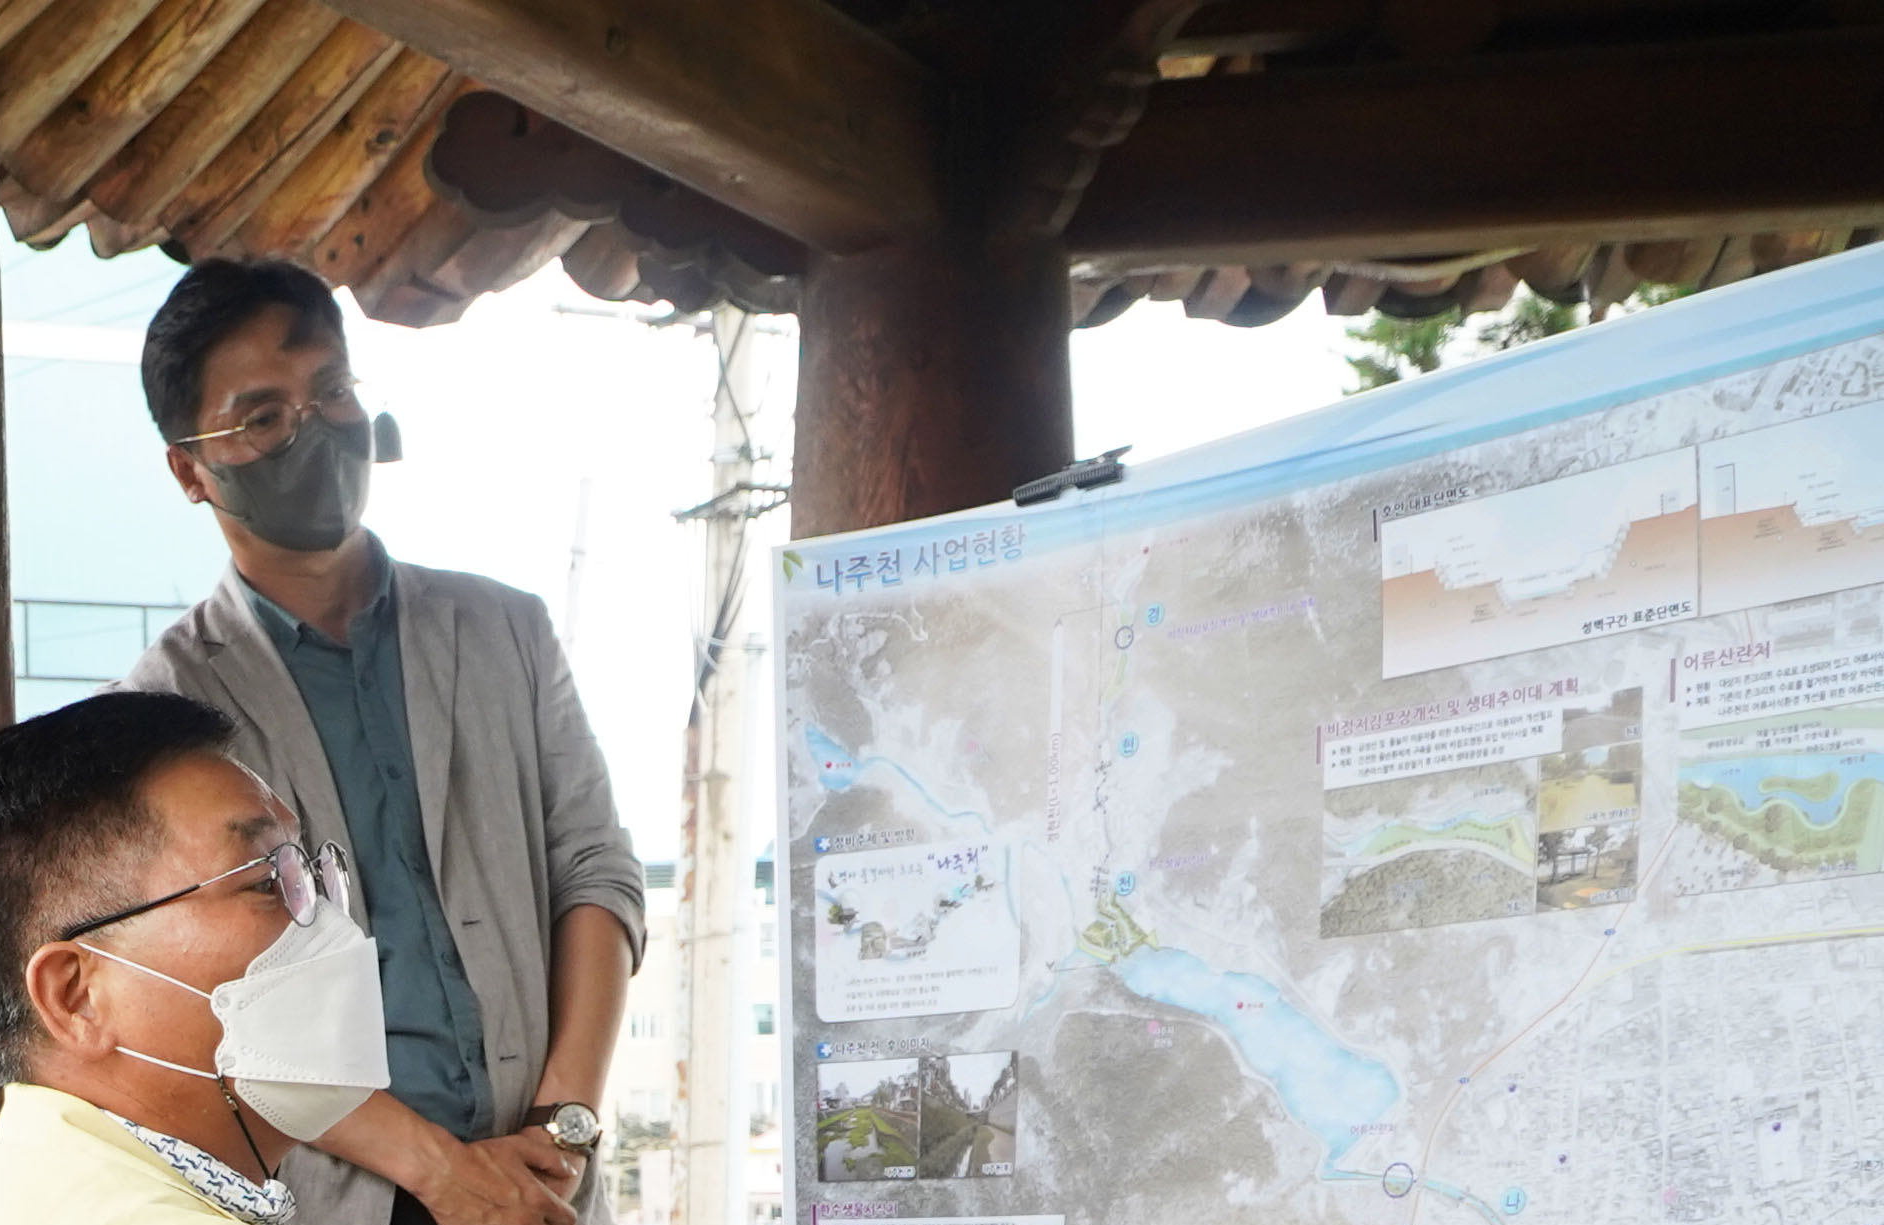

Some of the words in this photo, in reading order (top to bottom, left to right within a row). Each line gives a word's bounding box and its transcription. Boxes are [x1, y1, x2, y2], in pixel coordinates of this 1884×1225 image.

[816, 549, 902, 594] 나주천
[913, 523, 1026, 577] 사업현황
[1684, 641, 1771, 671] 어류산란처
[1447, 702, 1460, 716] 및
[1466, 685, 1542, 713] 생태추이대
[1549, 678, 1579, 696] 계획
